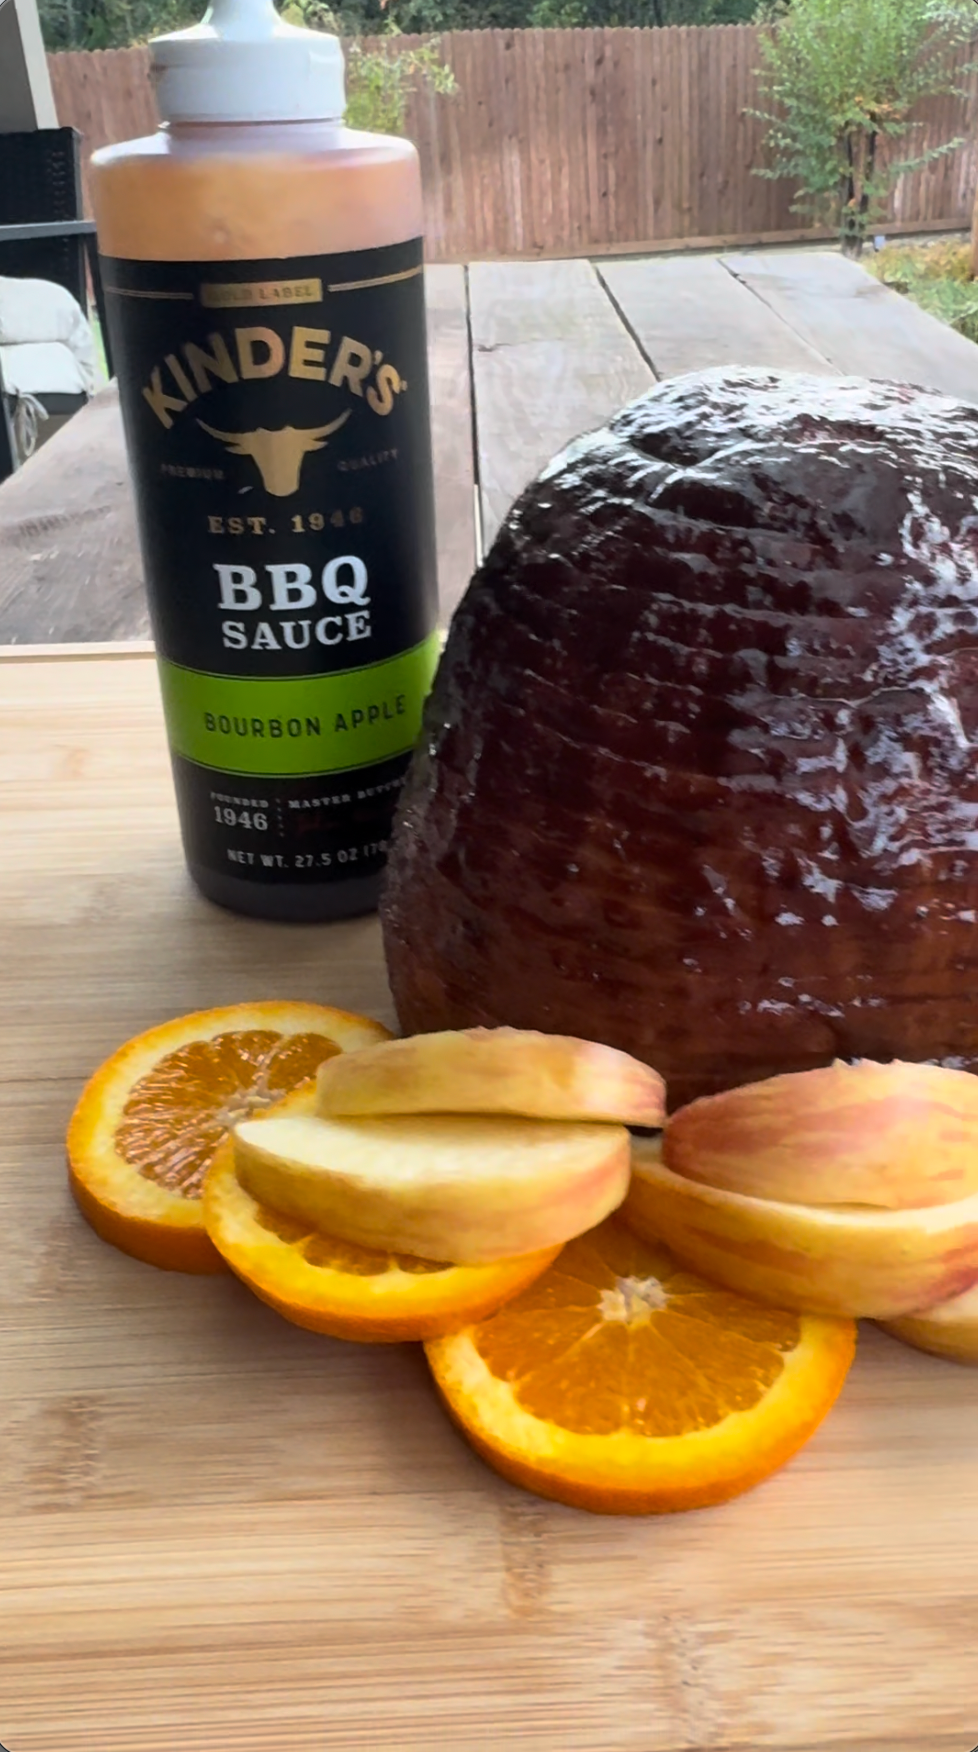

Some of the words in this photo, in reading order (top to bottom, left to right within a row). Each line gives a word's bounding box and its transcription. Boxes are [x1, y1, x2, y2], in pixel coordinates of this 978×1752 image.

[259, 284, 313, 300] LABEL
[142, 326, 402, 430] KINDER'S
[160, 463, 227, 481] PREMIUM
[337, 448, 400, 472] QUALITY
[207, 515, 277, 536] EST.
[291, 506, 364, 533] 1946
[213, 555, 371, 611] BBQ
[222, 610, 372, 650] SAUCE
[204, 712, 322, 738] BOURBON
[334, 694, 407, 732] APPLE
[288, 793, 351, 809] MASTER
[213, 805, 269, 831] 1946
[227, 848, 255, 865] NET
[260, 854, 289, 868] WT.
[295, 852, 332, 868] 27.5
[337, 848, 358, 863] OZ
